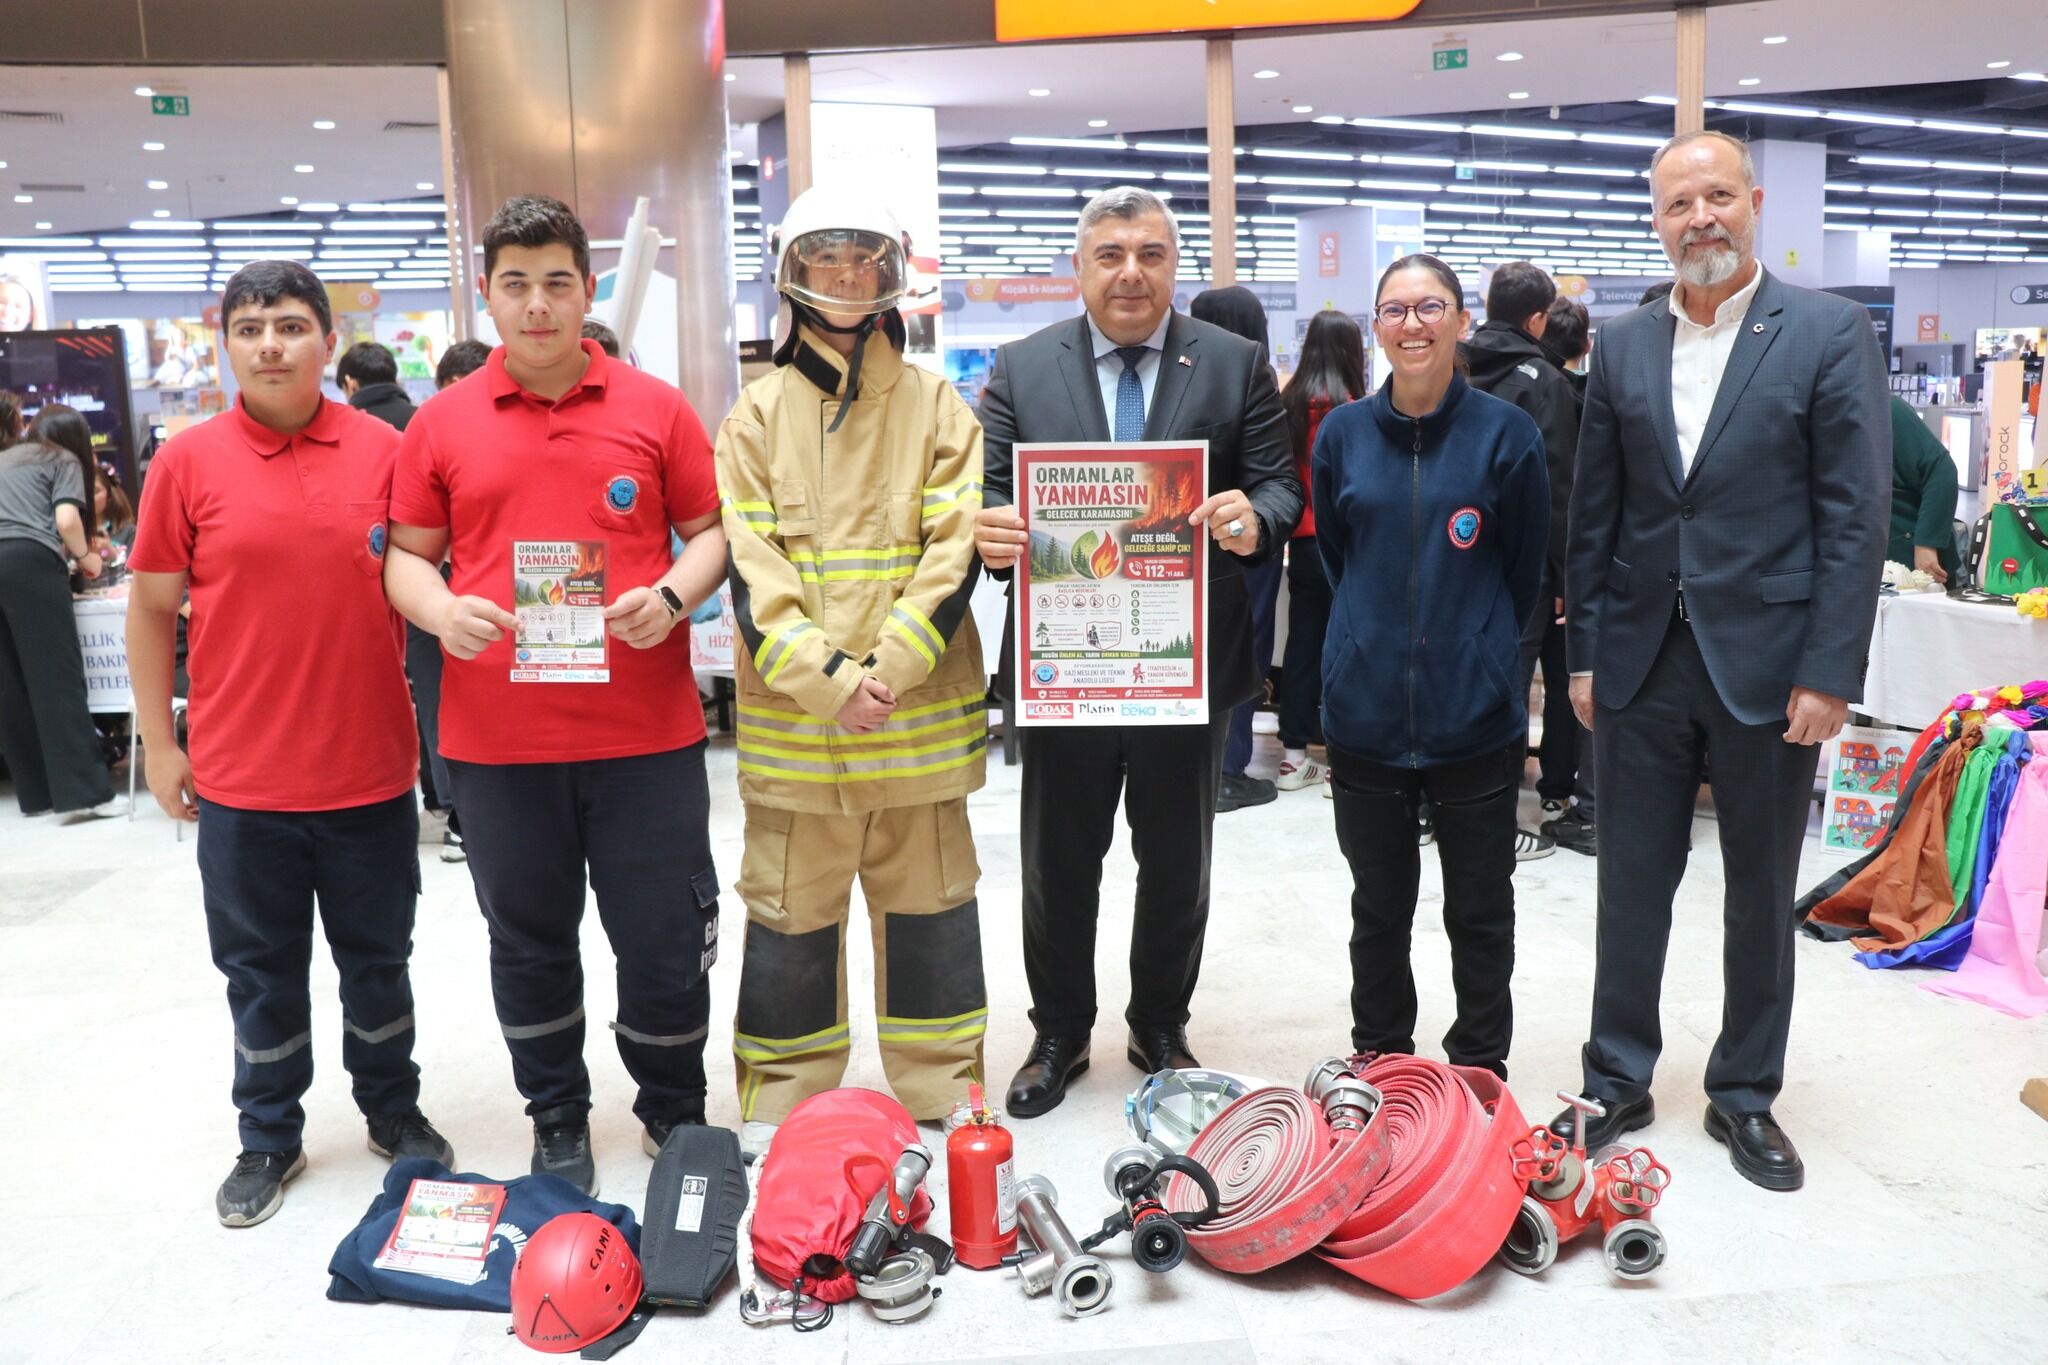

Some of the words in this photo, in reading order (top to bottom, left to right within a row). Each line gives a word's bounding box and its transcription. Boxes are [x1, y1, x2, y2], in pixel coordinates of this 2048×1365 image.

[1001, 284, 1028, 296] Küçük
[1030, 285, 1040, 294] Ev
[1041, 284, 1072, 294] Aletleri
[1601, 290, 1645, 302] Televizyo
[1036, 467, 1134, 484] ORMANLAR
[2027, 473, 2038, 488] 1
[1034, 485, 1148, 506] YANMASIN
[1046, 509, 1080, 520] GELECEK
[1081, 508, 1133, 519] KARAMASIN!
[1130, 534, 1154, 544] ATEŞE
[1156, 532, 1180, 544] DEĞİL,
[518, 544, 572, 554] ORMANLAR
[1124, 544, 1156, 552] GELECEĞE
[1156, 544, 1176, 552] SAHİP
[1178, 544, 1191, 554] ÇIK!
[518, 555, 580, 566] YANMASIN
[1144, 565, 1164, 578] 112
[88, 676, 130, 690] ETLE
[1036, 704, 1070, 714] ODAK
[1079, 703, 1115, 714] Platin
[1121, 704, 1156, 716] beka
[418, 1188, 474, 1199] YANMASIN
[590, 1227, 611, 1271] CAMP
